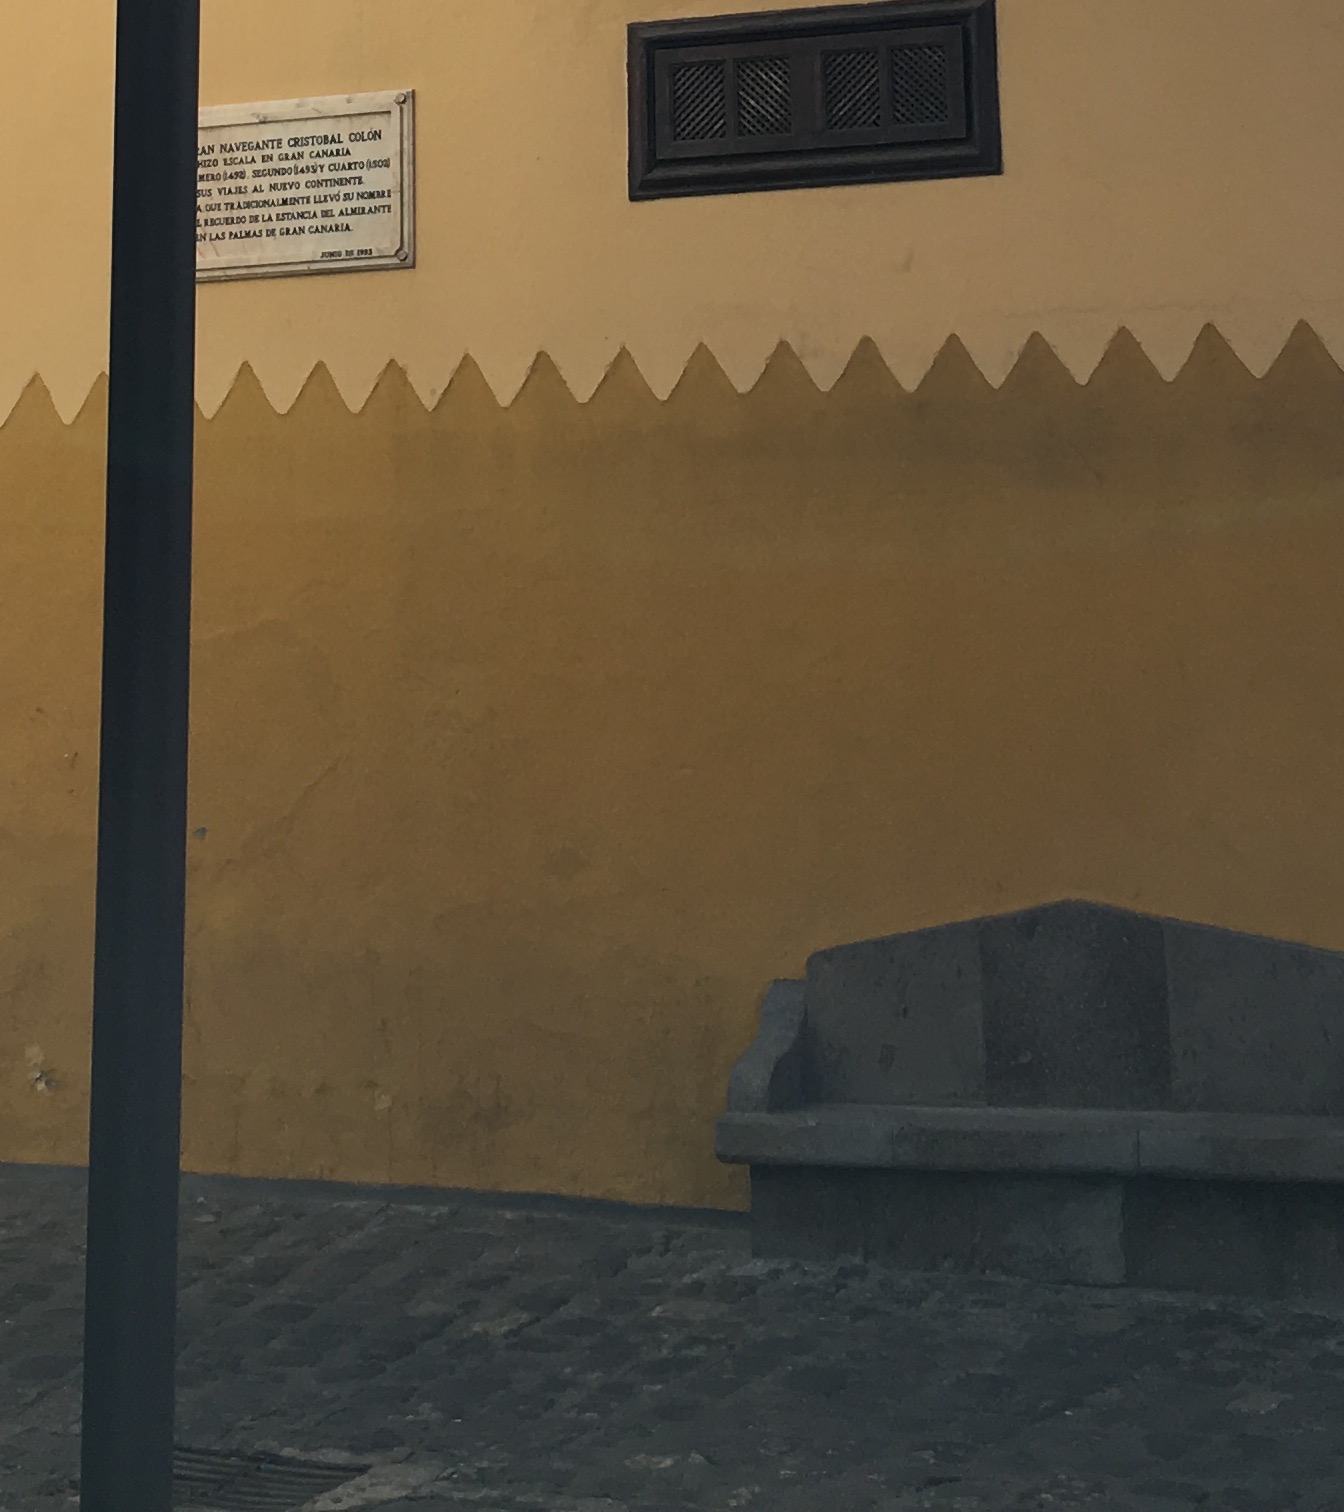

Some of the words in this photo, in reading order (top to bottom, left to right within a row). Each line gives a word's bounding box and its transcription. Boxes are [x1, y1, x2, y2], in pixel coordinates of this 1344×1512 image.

[220, 138, 283, 154] NAVEGANTE
[287, 133, 343, 147] CRISTOBAL
[223, 155, 256, 166] ESCALA
[261, 153, 273, 163] EN
[278, 151, 304, 162] GRAN
[309, 148, 351, 159] CANARIA
[252, 167, 292, 178] SEGUNDO
[328, 161, 365, 172] CUARTO
[217, 186, 248, 196] VIAJES
[252, 184, 264, 194] AL
[269, 181, 300, 192] NUEVO
[224, 196, 311, 211] TRADICIONALMENTE
[342, 192, 354, 202] SU
[356, 189, 391, 200] NOMBRE
[204, 215, 246, 227] RECUERDO
[249, 214, 259, 223] DE
[262, 214, 273, 223] LA
[276, 211, 317, 222] ESTANCIA
[321, 209, 335, 218] DEL
[338, 204, 391, 217] ALMIRANTE
[209, 232, 226, 242] LAS
[228, 229, 263, 240] PALMAS
[266, 228, 276, 237] DE
[279, 226, 305, 236] GRAN
